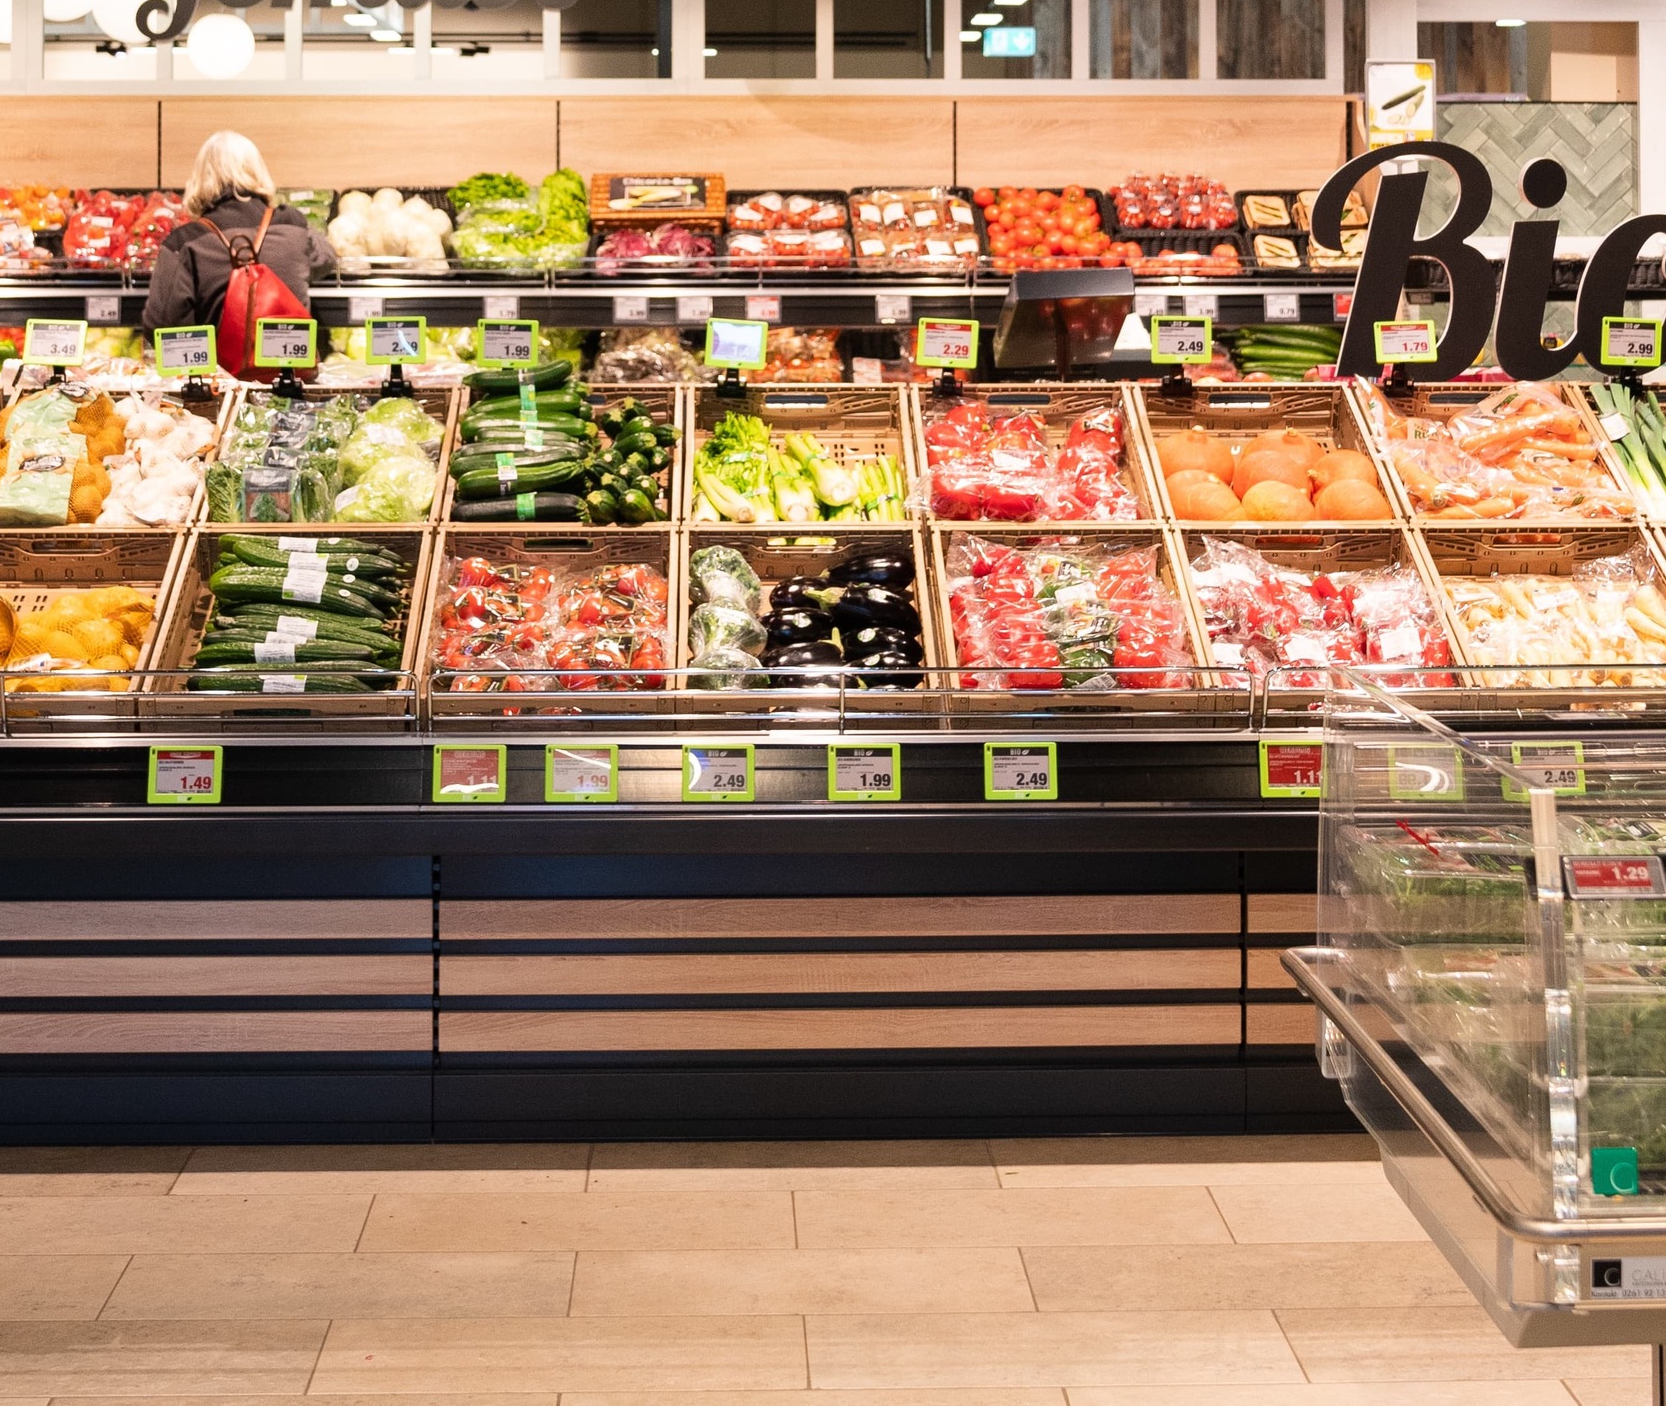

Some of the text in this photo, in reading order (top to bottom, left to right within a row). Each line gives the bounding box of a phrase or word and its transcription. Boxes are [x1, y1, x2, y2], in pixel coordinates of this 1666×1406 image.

[50, 344, 76, 354] 3.49
[282, 344, 307, 355] 1.99
[392, 341, 418, 352] 2.9
[505, 345, 530, 356] 1.99
[943, 344, 969, 355] 2.29
[1177, 341, 1203, 352] 2.49
[1402, 342, 1428, 352] 1.79
[1627, 343, 1653, 354] 2.99
[183, 351, 208, 363] 1.99
[180, 776, 211, 789] 1.49
[577, 774, 608, 787] 1.99
[713, 775, 745, 788] 2.49
[859, 774, 891, 787] 1.99
[1016, 773, 1047, 786] 2.49
[1544, 771, 1575, 783] 2.49
[1612, 866, 1649, 880] 1.29
